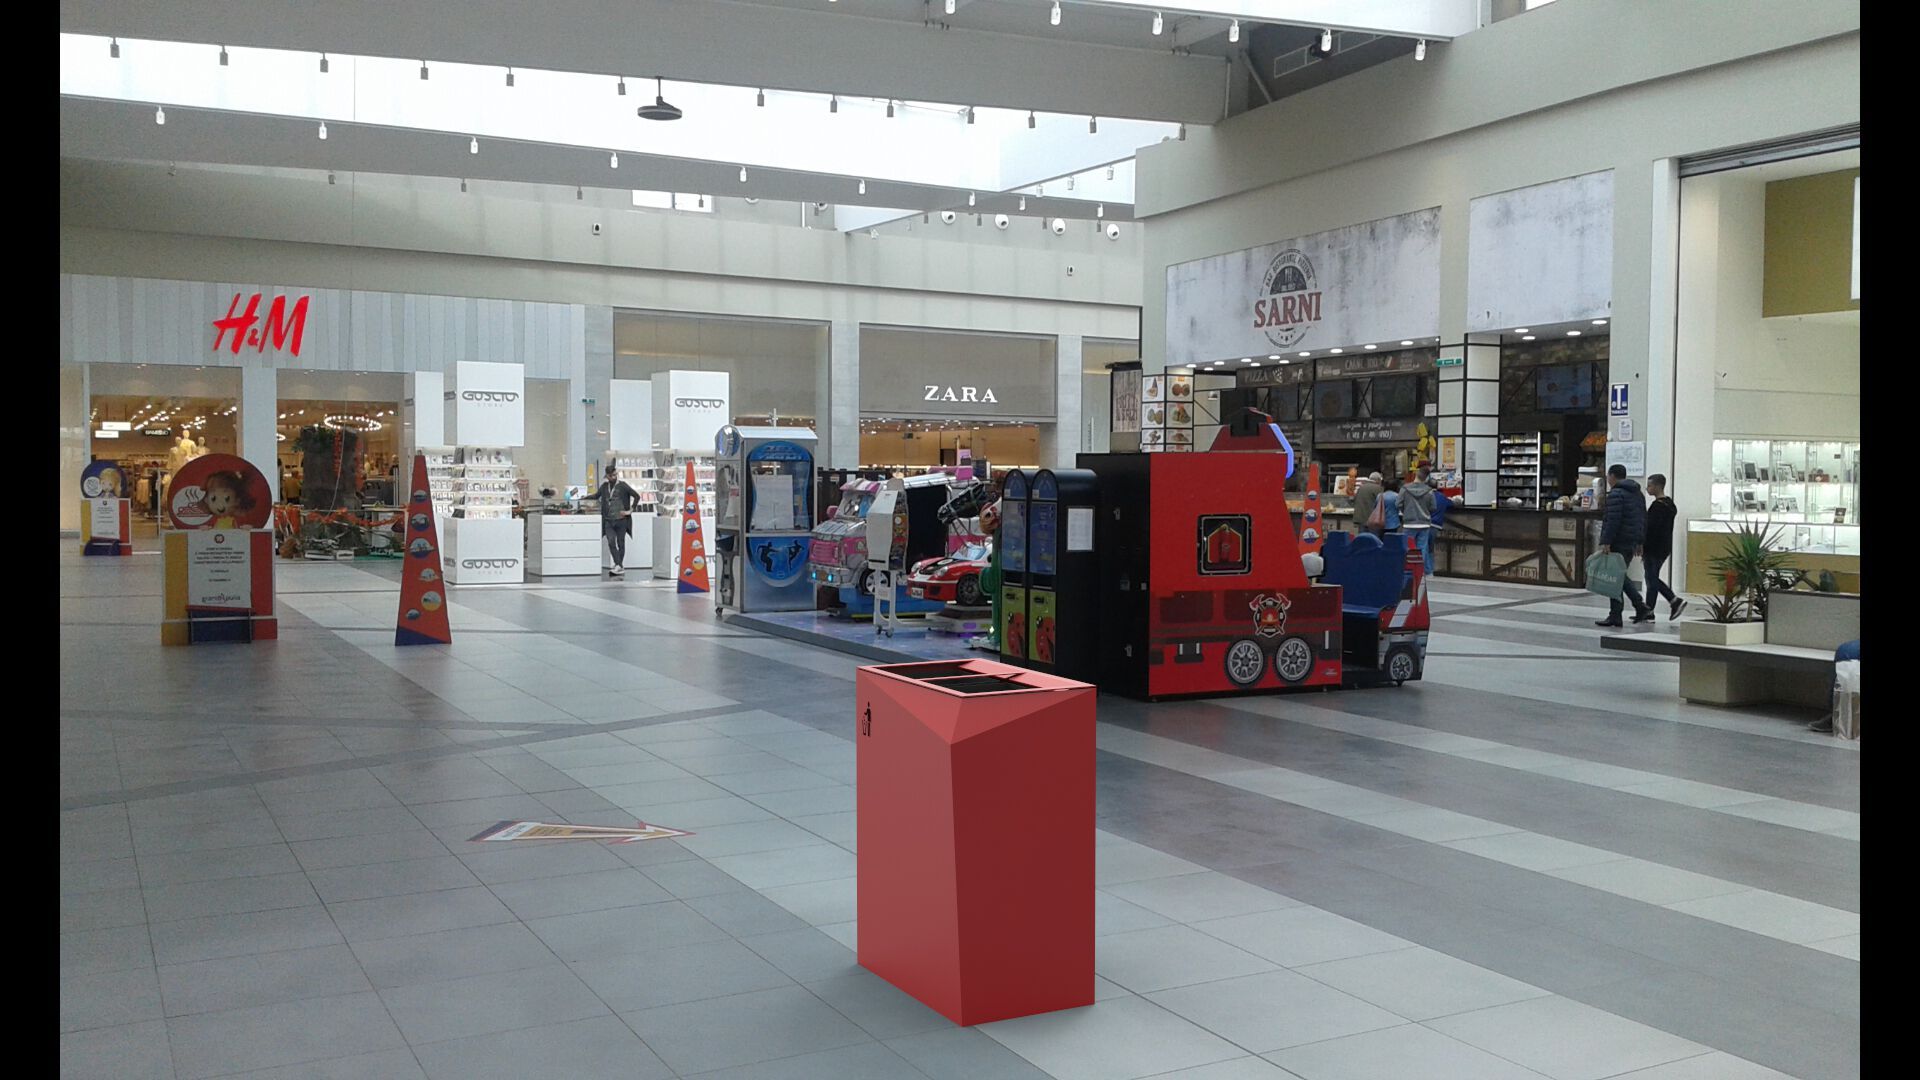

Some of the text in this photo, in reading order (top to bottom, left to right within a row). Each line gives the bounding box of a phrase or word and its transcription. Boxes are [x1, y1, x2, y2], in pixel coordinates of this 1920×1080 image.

[212, 292, 310, 357] H&M
[1253, 292, 1322, 328] SARNI
[924, 385, 998, 403] ZARA
[1614, 385, 1625, 409] T
